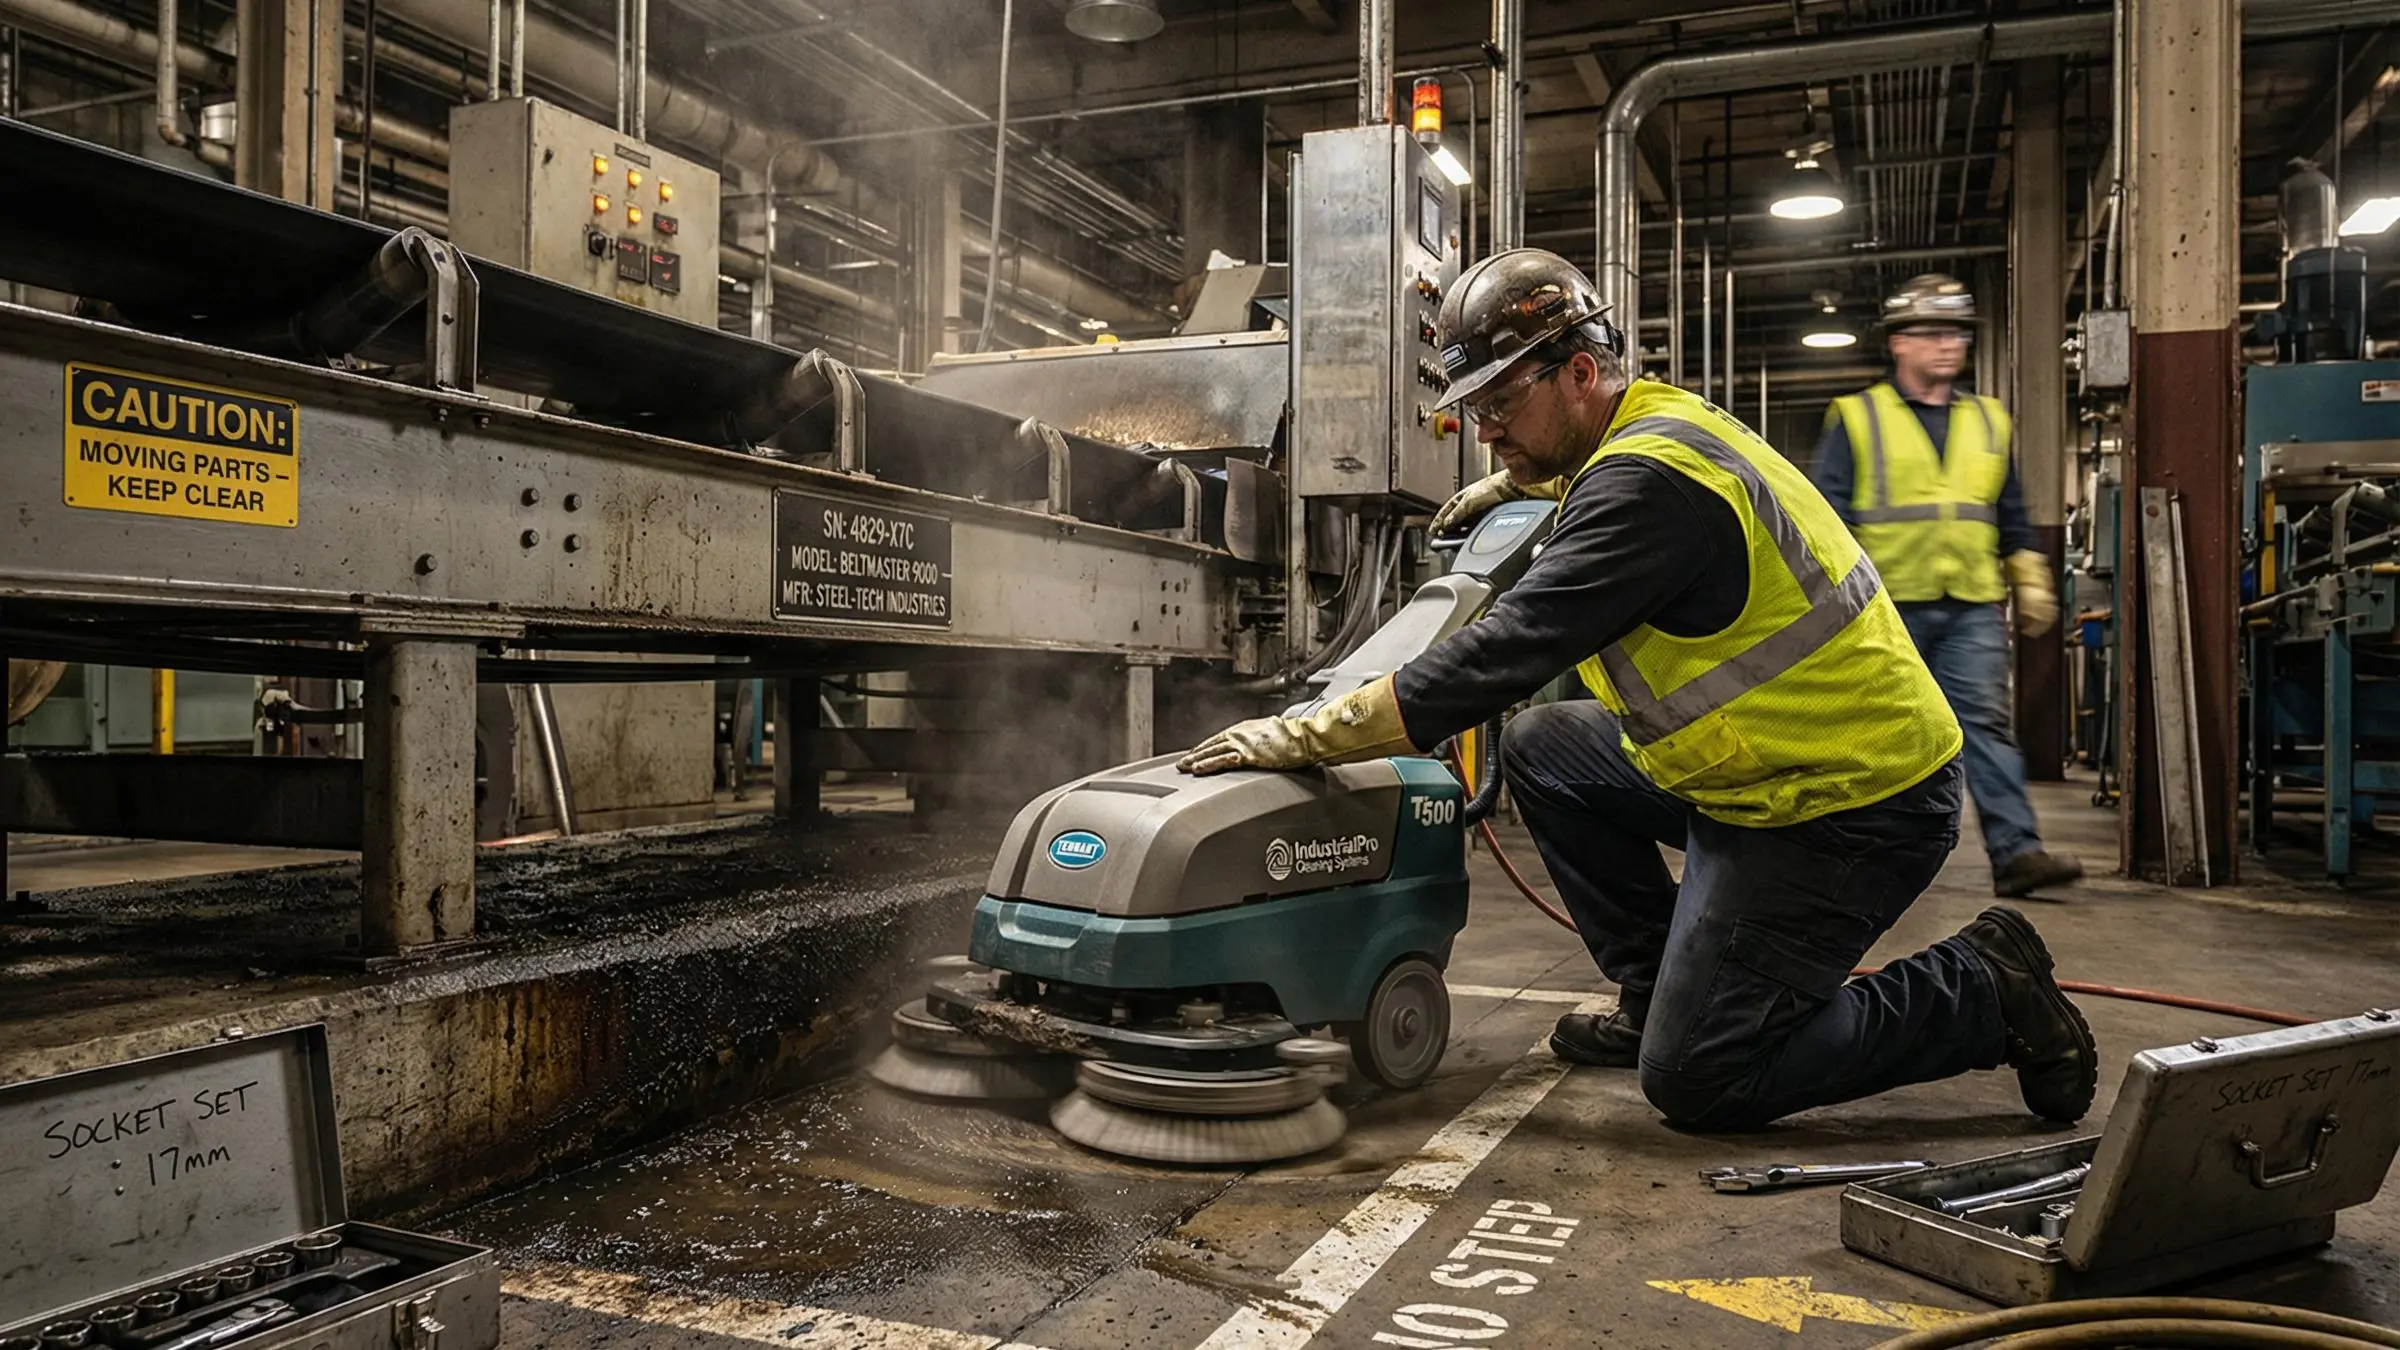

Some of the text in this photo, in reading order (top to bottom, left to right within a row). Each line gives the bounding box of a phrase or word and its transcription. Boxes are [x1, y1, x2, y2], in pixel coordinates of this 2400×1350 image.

[82, 380, 286, 447] CAUTION:
[79, 438, 186, 473] MOVING
[194, 453, 270, 484] PARTS
[108, 475, 265, 512] KEEP CLEAR
[823, 509, 915, 550] SN: 4829-X7C
[791, 545, 938, 585] MODEL: BELTMASTER 9000
[783, 580, 946, 617] MFR: STEEL-TECH INDUSTRIES
[1411, 795, 1456, 827] T500
[2211, 1072, 2295, 1112] SOCKET
[2297, 1064, 2342, 1094] SET
[44, 1080, 259, 1159] SOCKET SET
[148, 1146, 231, 1186] 17mm
[1430, 1199, 1581, 1296] STEP
